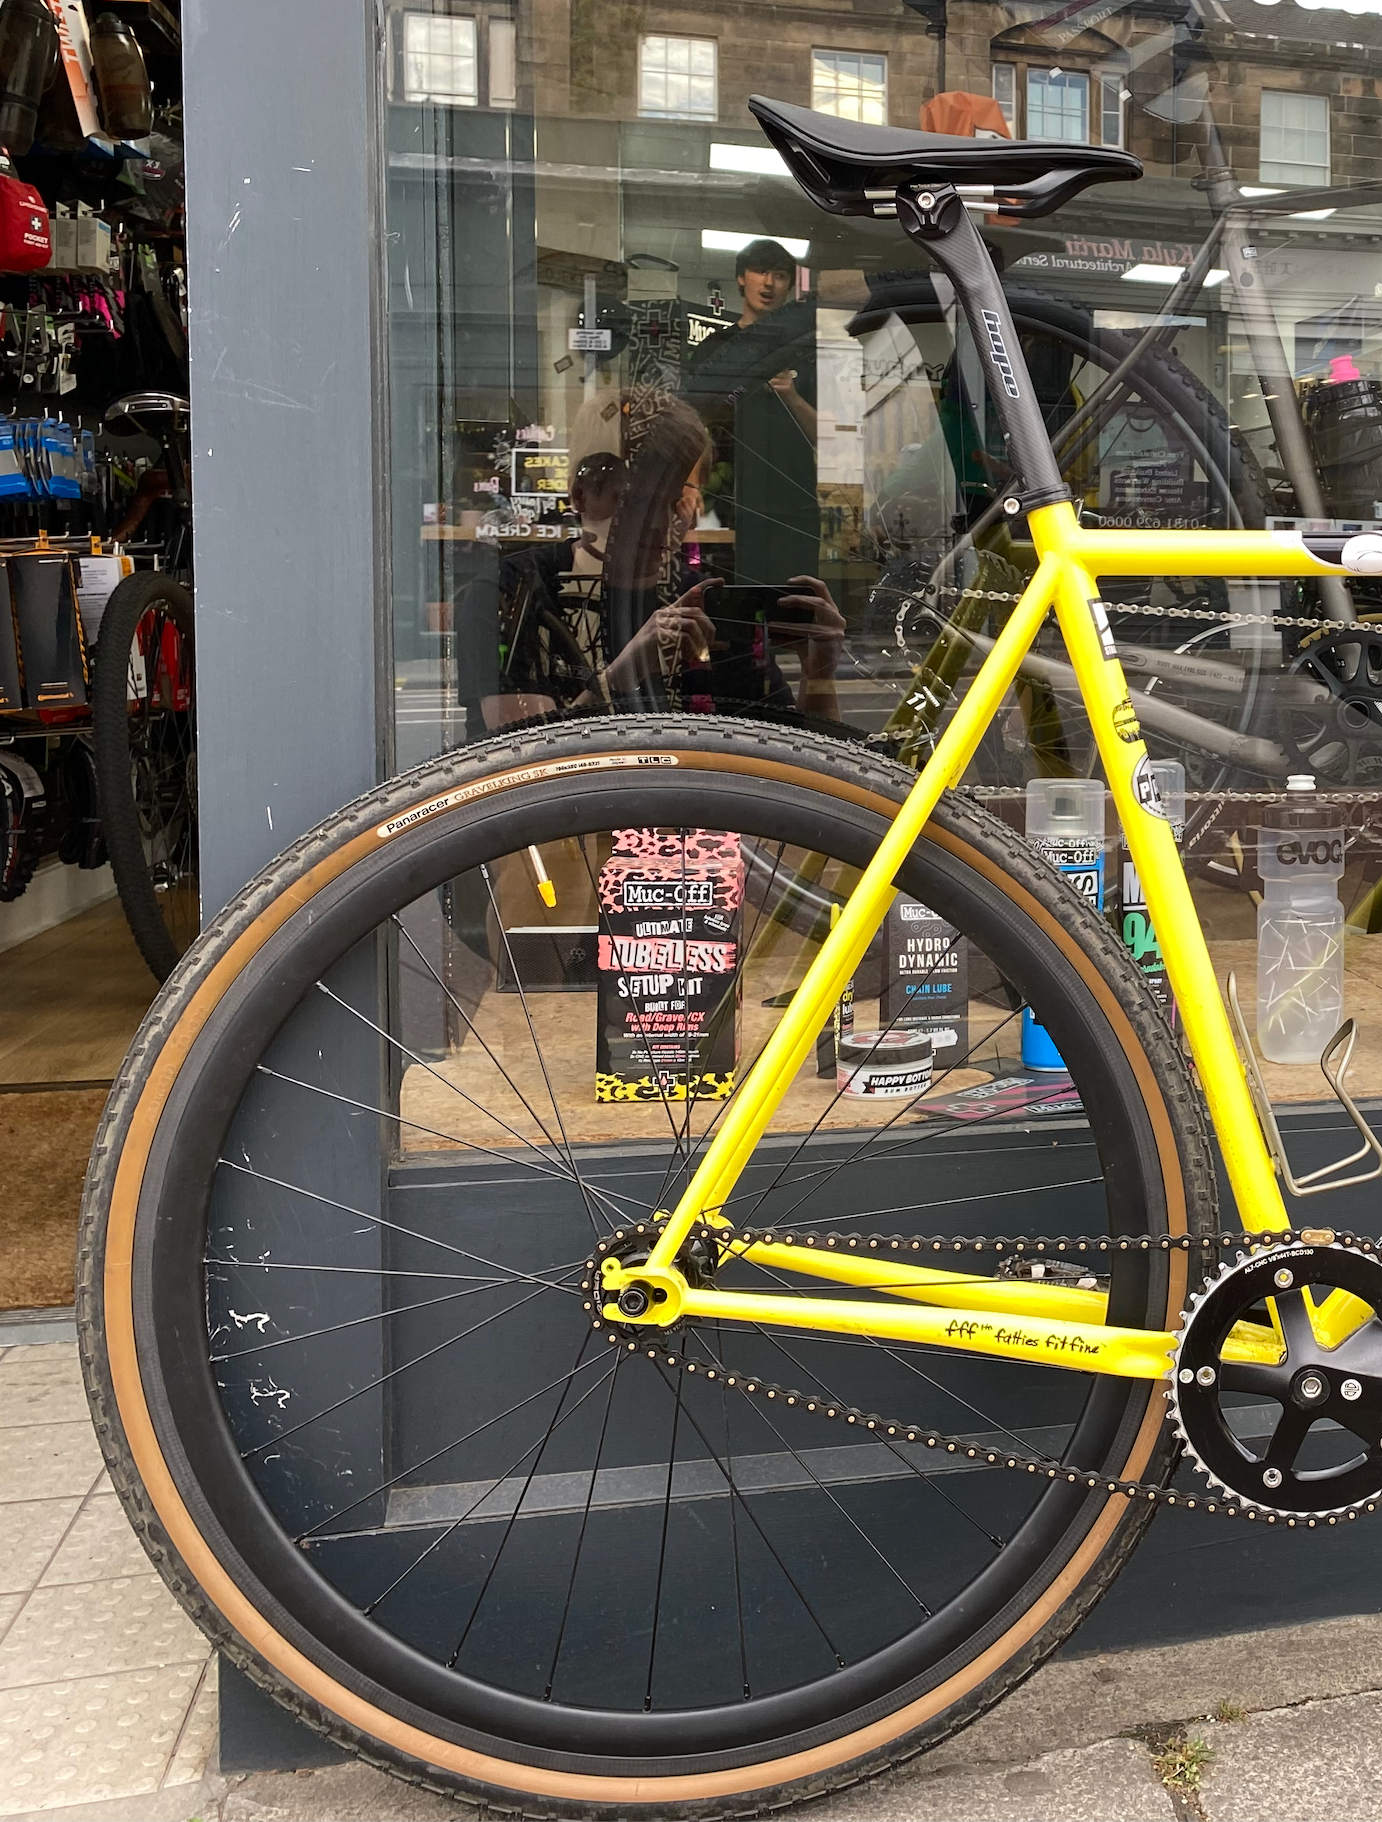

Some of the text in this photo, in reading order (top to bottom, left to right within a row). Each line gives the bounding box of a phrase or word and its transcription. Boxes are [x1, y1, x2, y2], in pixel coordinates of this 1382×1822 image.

[981, 309, 1020, 399] hope
[386, 798, 450, 834] Panaracer
[454, 772, 532, 802] GRAVELKING
[533, 767, 549, 779] SK
[628, 884, 709, 903] Muc-Off
[907, 938, 950, 952] HYDRO
[617, 974, 674, 998] SETUP
[933, 983, 953, 994] LUBE
[645, 1001, 669, 1012] BUILT
[652, 1023, 675, 1033] Deep
[871, 1074, 904, 1087] HAPPY
[994, 1328, 1040, 1347] fatties
[1045, 1334, 1068, 1350] fit
